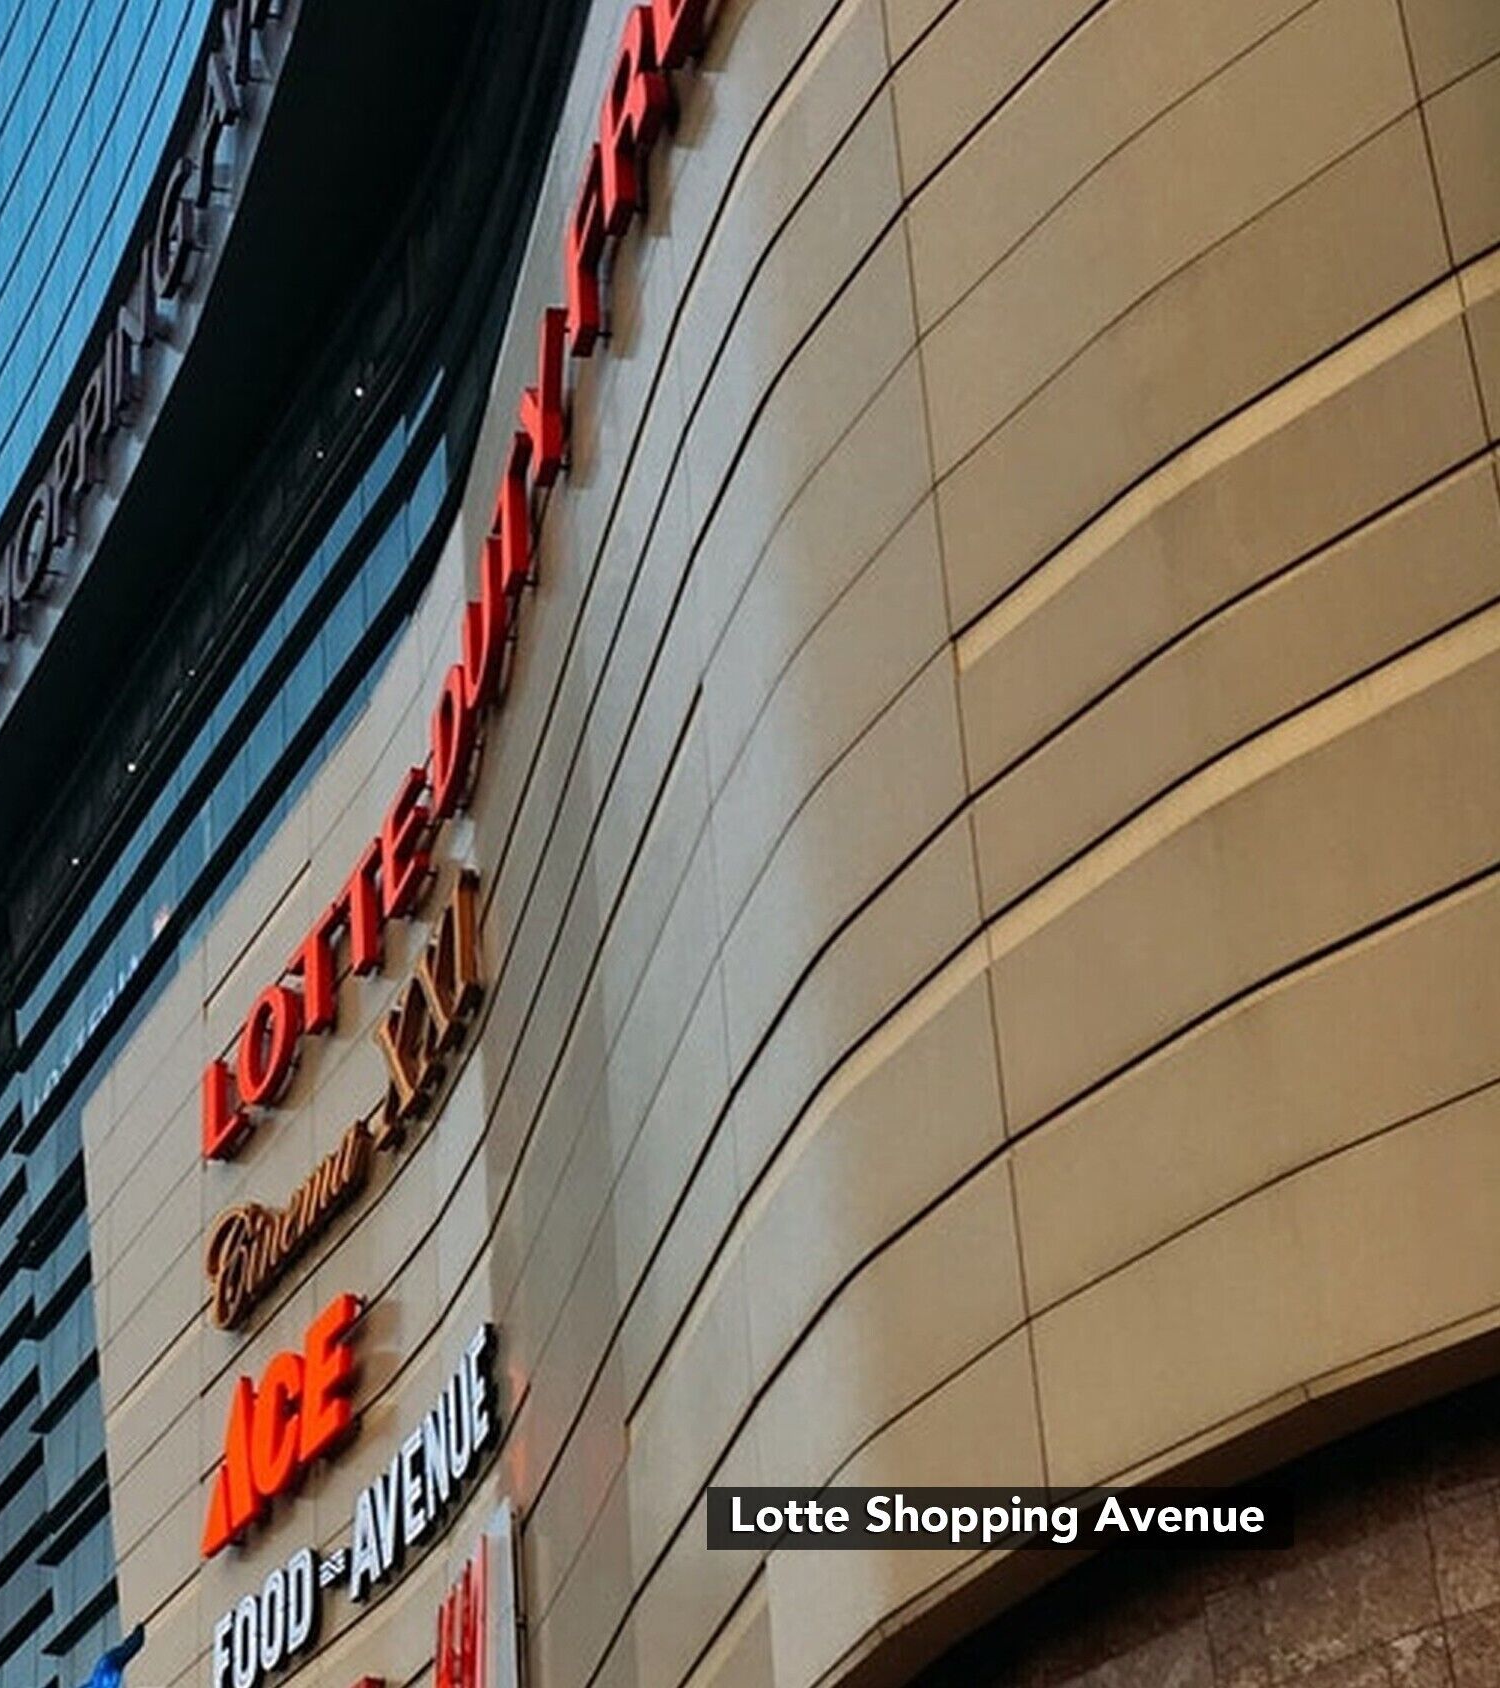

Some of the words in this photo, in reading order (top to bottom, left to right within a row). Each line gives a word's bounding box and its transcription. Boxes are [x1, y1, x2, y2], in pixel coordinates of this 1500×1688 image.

[202, 768, 439, 1161] LOTTE
[206, 1119, 376, 1330] Cinema
[374, 864, 487, 1153] XXI
[201, 1291, 368, 1559] ACE
[211, 1546, 320, 1688] FOOD
[349, 1321, 500, 1604] AVENUE
